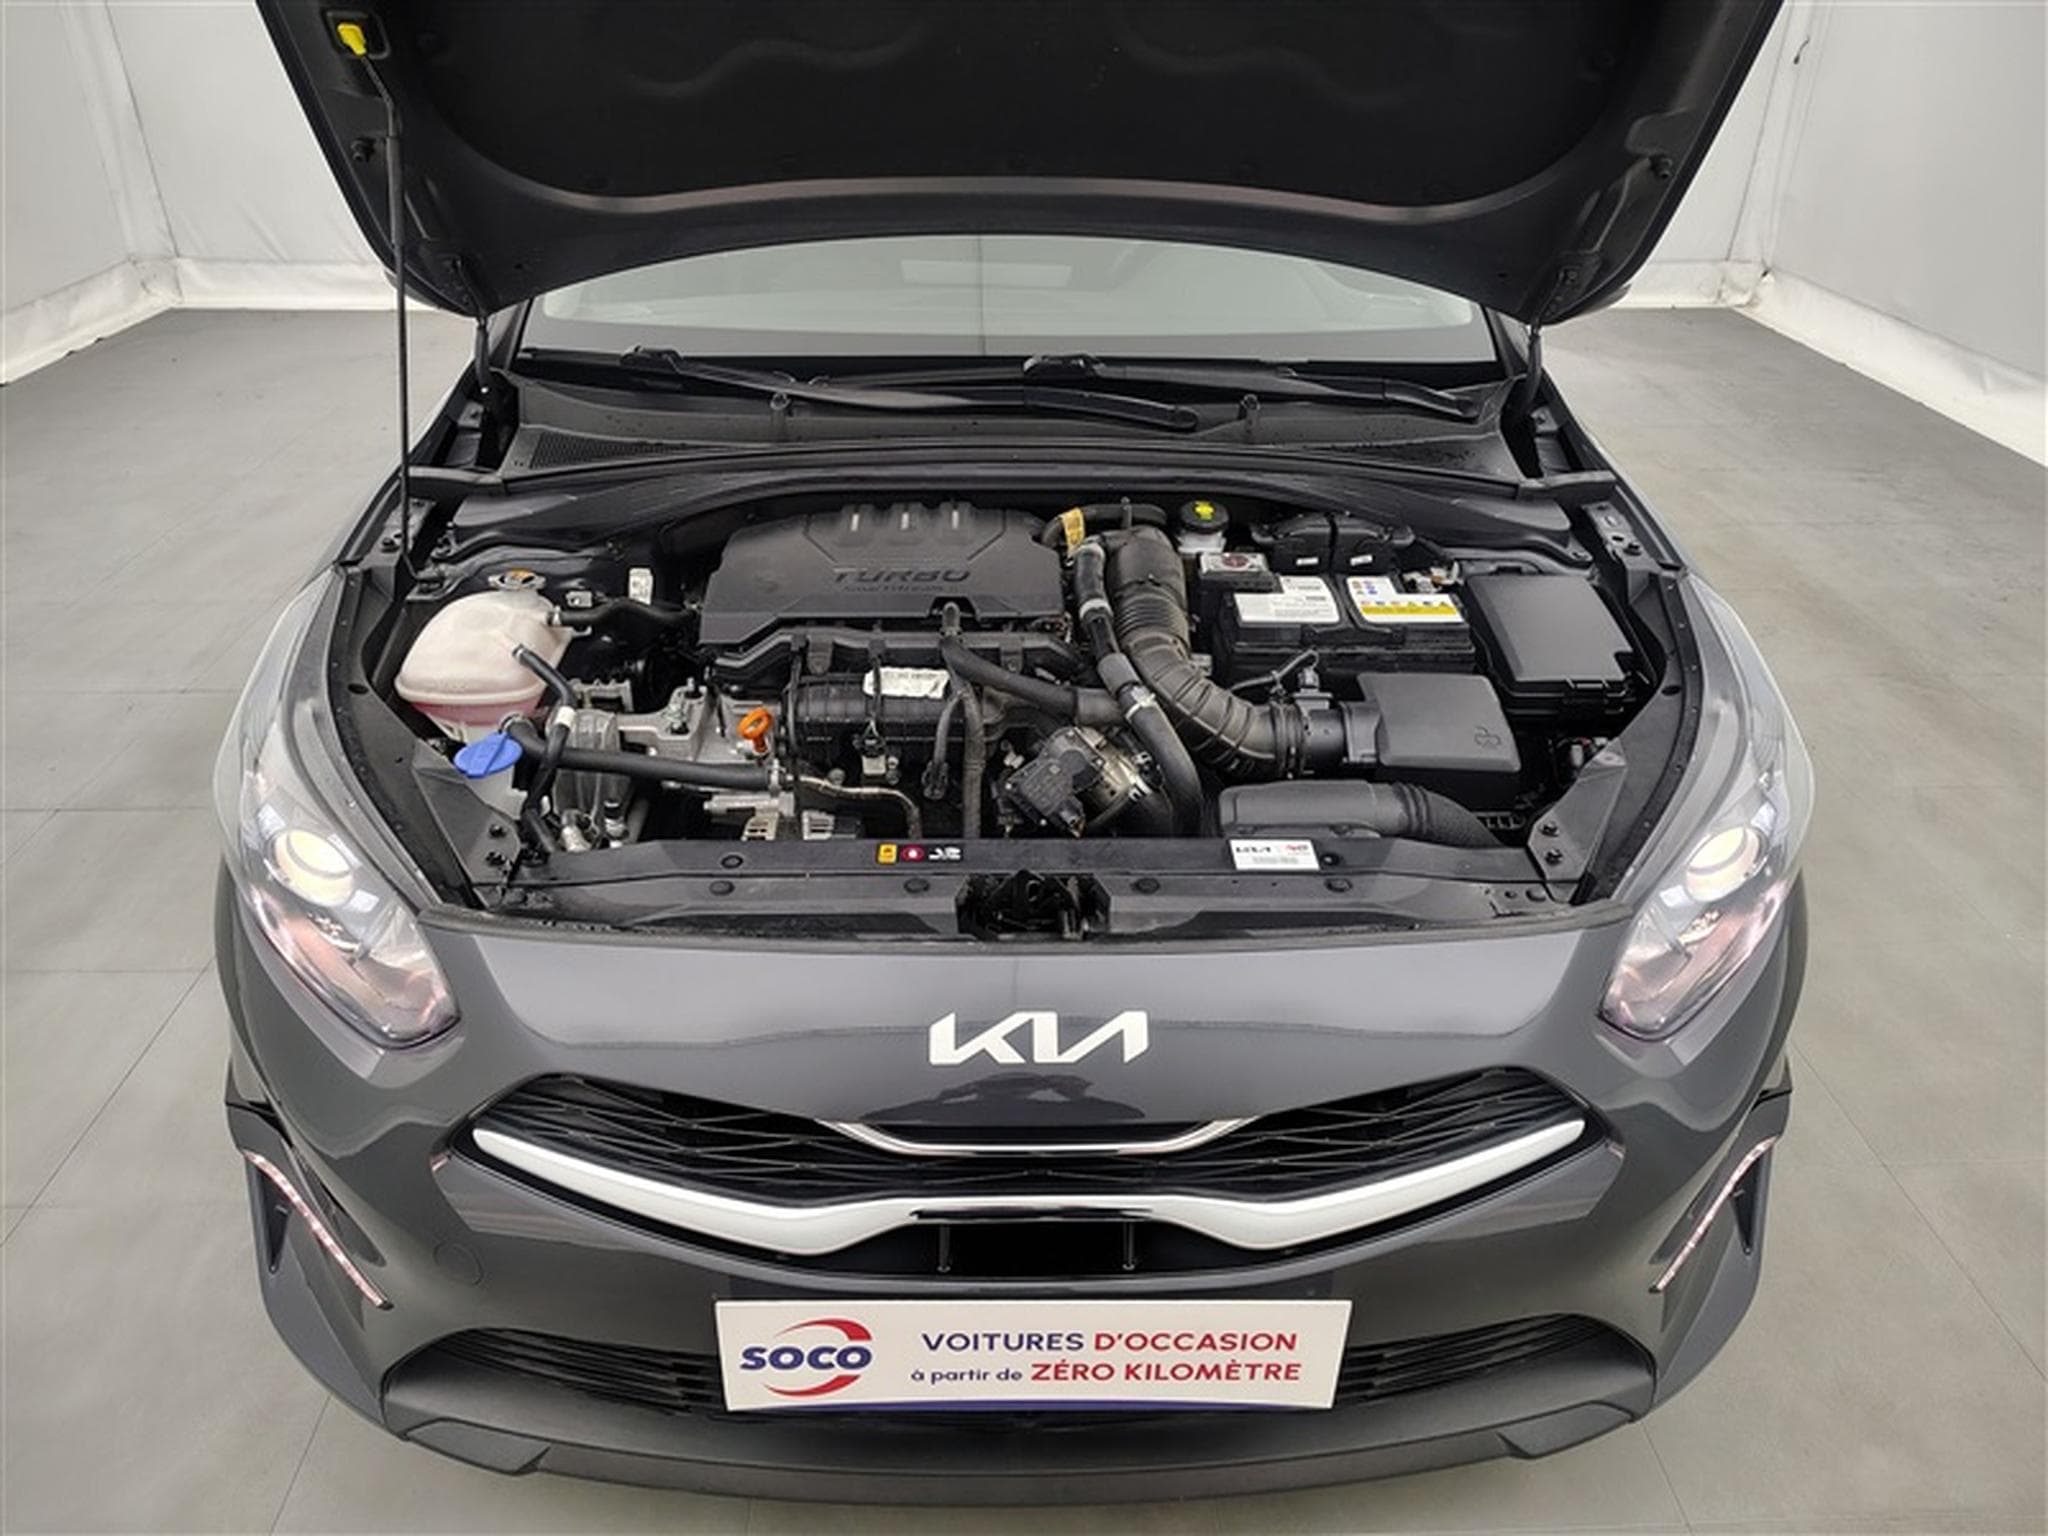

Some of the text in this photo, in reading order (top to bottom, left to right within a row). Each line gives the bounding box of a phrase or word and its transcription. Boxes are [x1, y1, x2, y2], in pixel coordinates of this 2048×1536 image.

[833, 567, 971, 583] TURBO
[929, 1011, 1148, 1065] KIA
[921, 1332, 1298, 1351] VOITURES D'OCCASION
[740, 1345, 873, 1371] SOCO
[911, 1358, 1302, 1385] à partir de ZÉRO KILOMÈTRE
